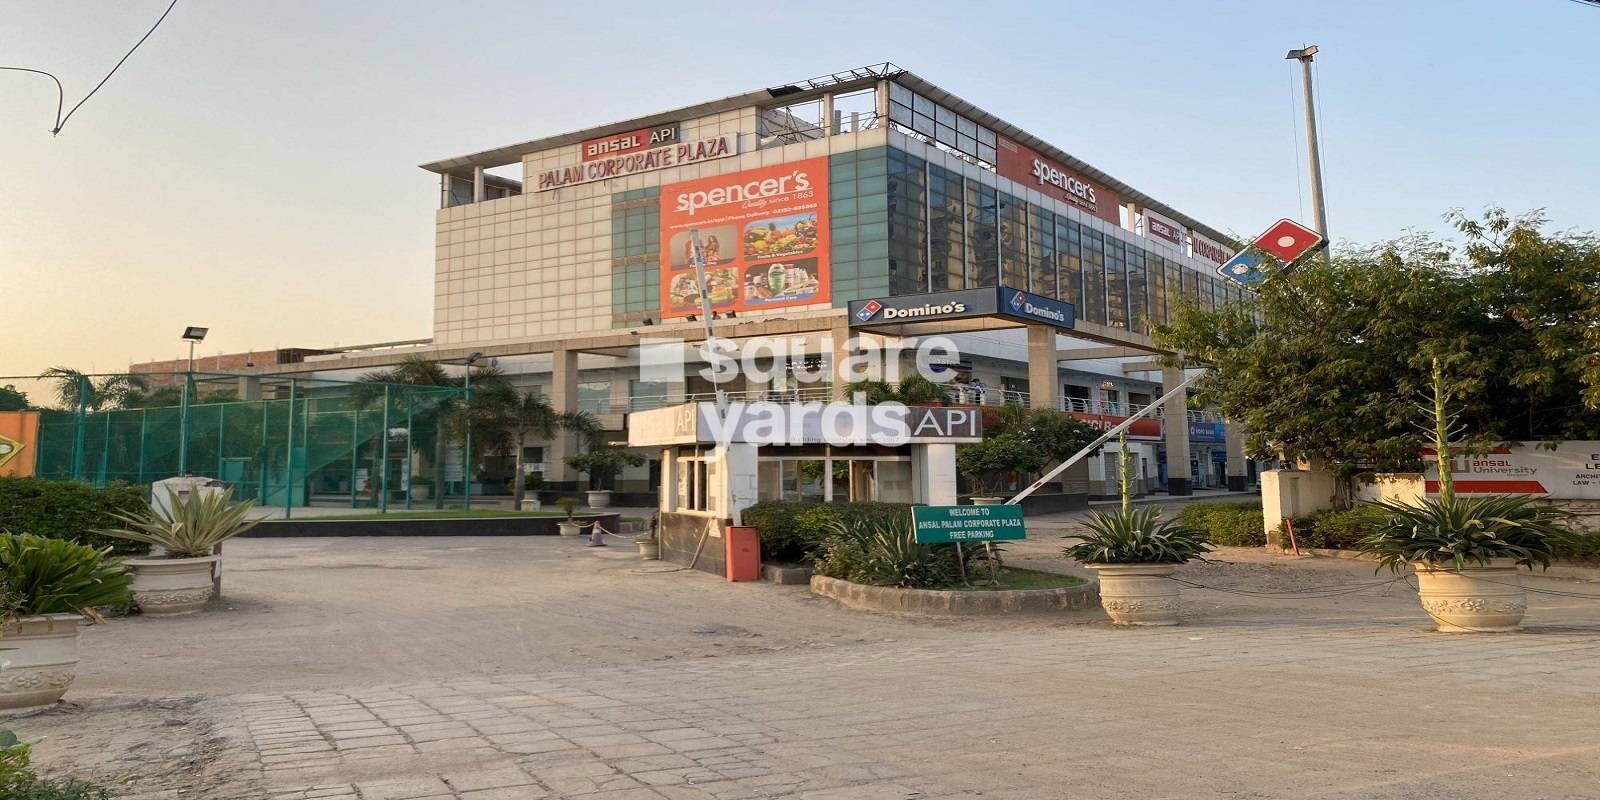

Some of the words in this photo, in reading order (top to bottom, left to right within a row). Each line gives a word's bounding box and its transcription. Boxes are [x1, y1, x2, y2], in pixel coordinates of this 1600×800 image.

[588, 135, 641, 156] ansal
[650, 127, 676, 145] API
[538, 166, 584, 189] PALAM
[587, 147, 672, 180] CORPORATE
[677, 136, 729, 164] PLAZA
[1033, 158, 1096, 204] spencer's
[676, 170, 810, 215] spencer's
[793, 190, 814, 200] 1863
[883, 301, 966, 319] Domino's
[1024, 302, 1065, 322] Domino's
[676, 408, 694, 433] API
[914, 410, 977, 436] API
[1473, 459, 1512, 467] ansal
[1473, 466, 1537, 475] University
[949, 507, 980, 517] WELCOME
[981, 507, 990, 516] TO
[918, 520, 941, 530] ANSAL
[941, 520, 963, 529] PALAM
[963, 519, 1001, 528] CORPORATE
[1001, 518, 1022, 528] PLAZA
[949, 530, 966, 540] FREE
[967, 530, 995, 539] PARKING
